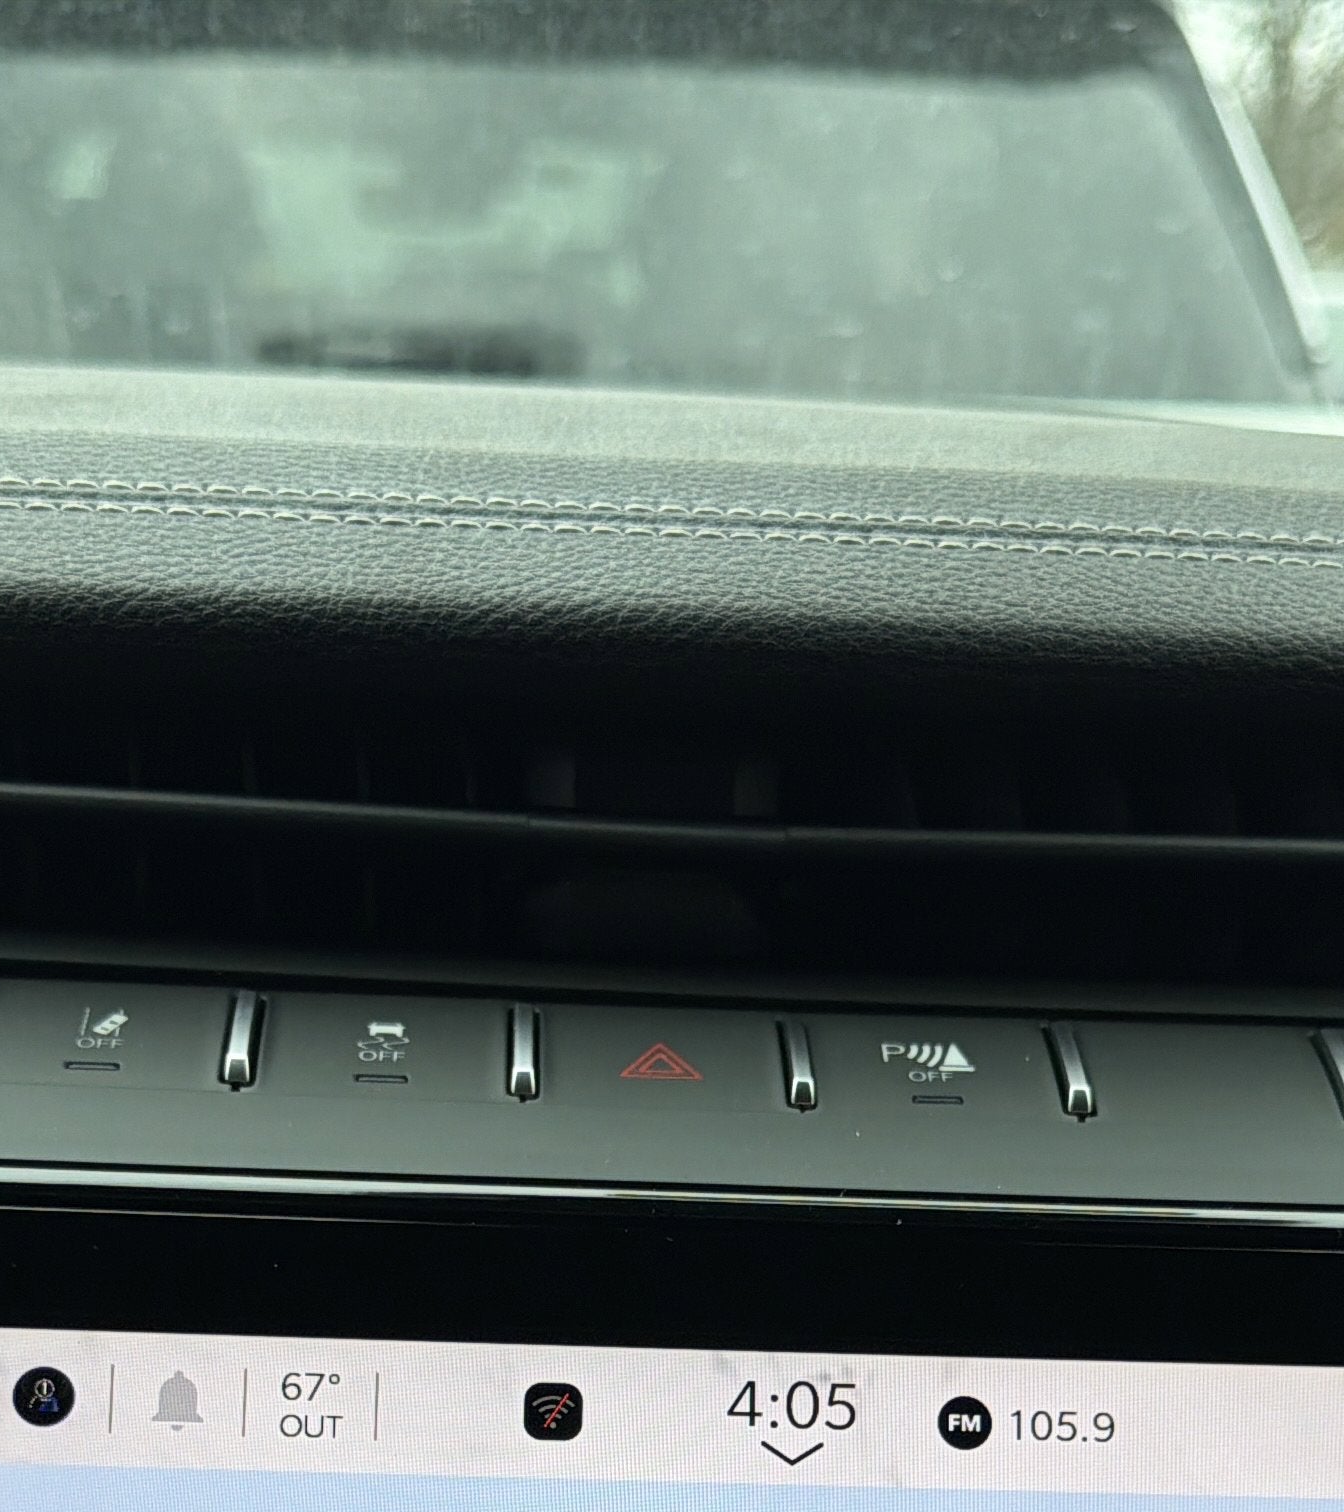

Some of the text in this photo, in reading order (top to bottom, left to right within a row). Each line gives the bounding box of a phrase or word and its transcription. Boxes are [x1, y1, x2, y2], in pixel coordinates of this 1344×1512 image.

[76, 1036, 123, 1049] OFF
[358, 1049, 406, 1062] OFF
[908, 1071, 953, 1082] OFF
[727, 1381, 857, 1430] 4:05
[280, 1414, 342, 1439] OUT
[948, 1414, 981, 1432] FM
[1010, 1410, 1115, 1443] 105.9
